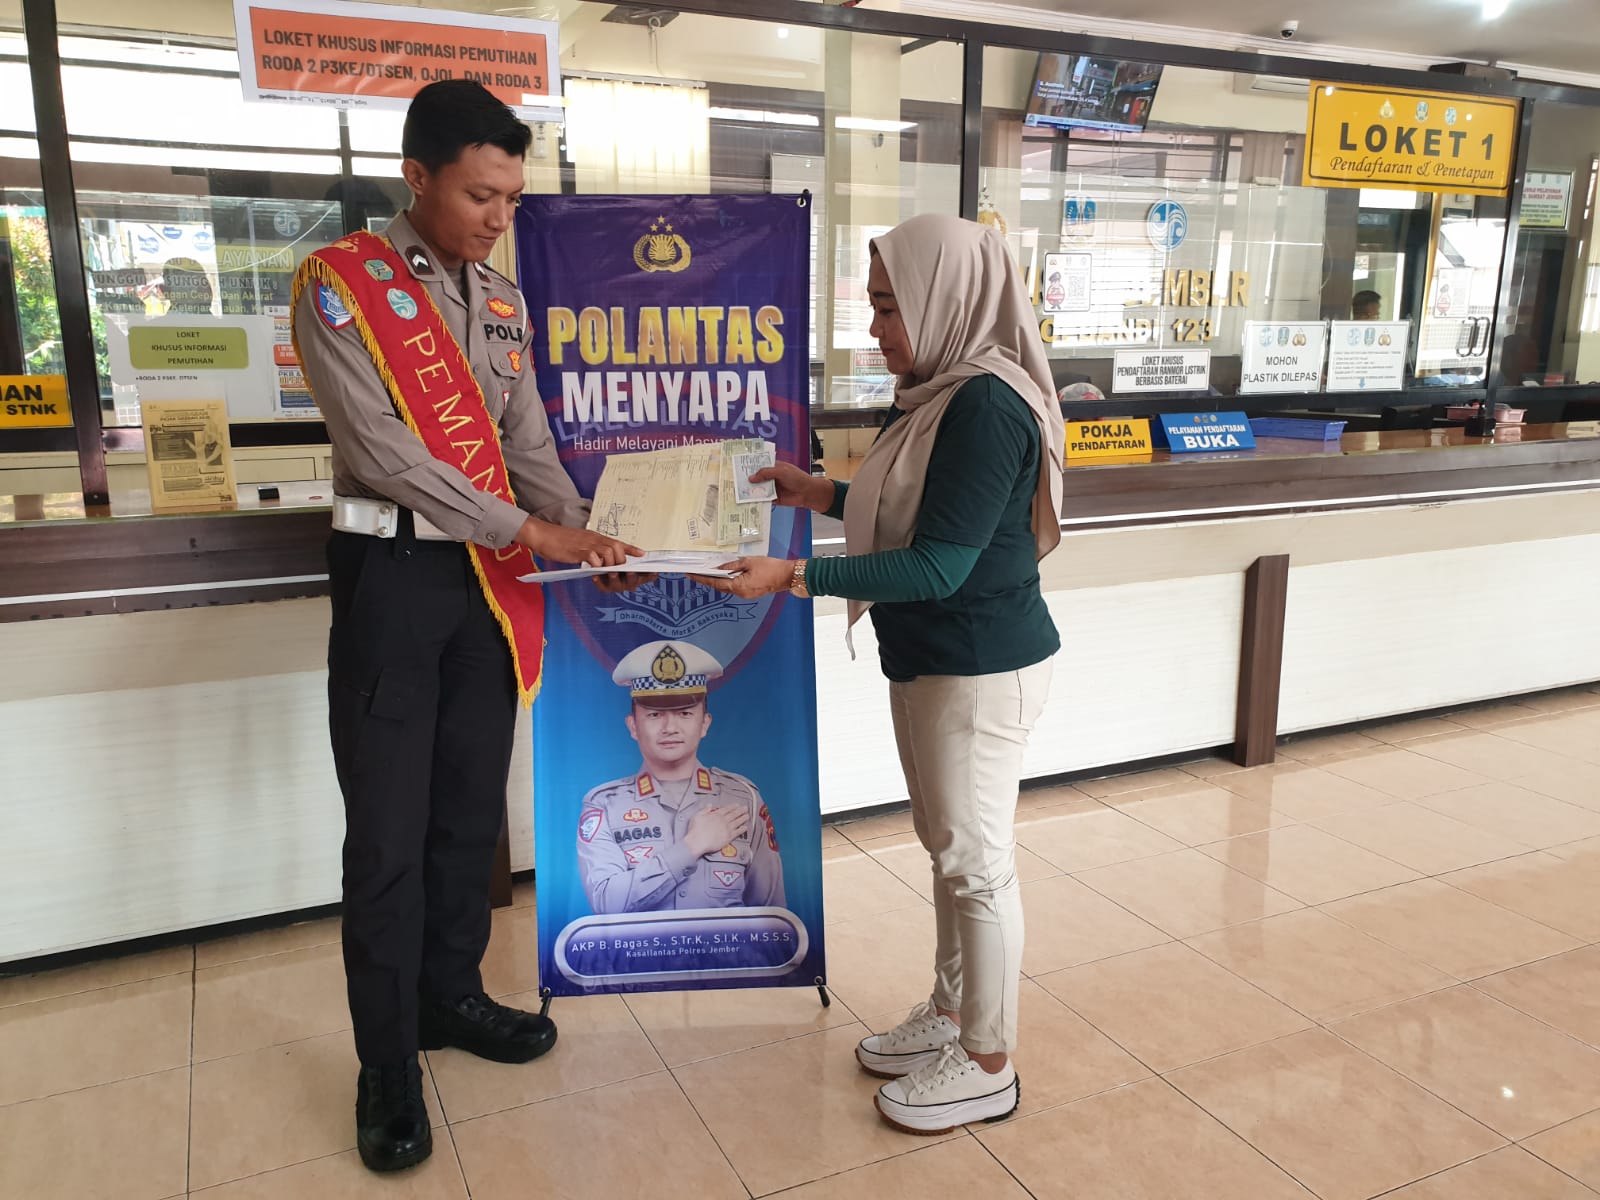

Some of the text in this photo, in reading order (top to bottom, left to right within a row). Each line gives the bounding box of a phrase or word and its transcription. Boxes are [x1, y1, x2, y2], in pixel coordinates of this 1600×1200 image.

[263, 28, 538, 66] LOKET KHUSUS INFORMASI PEMUTIHAN
[261, 54, 304, 74] RODA
[307, 58, 318, 74] 2
[320, 60, 418, 82] P3KE/DTSEN,
[464, 70, 493, 89] DAN
[496, 73, 532, 89] RODA
[534, 76, 542, 90] 3
[1339, 122, 1494, 161] LOKET 1
[1329, 155, 1495, 184] Pendaftaran & Penetapan
[176, 331, 201, 339] LOKET
[547, 305, 785, 365] POLANTAS
[1172, 317, 1214, 343] 123
[151, 344, 227, 352] KHUSUS INFORMASI
[167, 357, 214, 365] PEMUTIHAN
[1141, 355, 1184, 366] LOKET KHUSUS
[1265, 355, 1298, 366] MOHON
[1117, 365, 1206, 376] PENDAFTARAN RANMOR LISTRIK
[1243, 371, 1318, 383] PLASTIK DILEPAS
[1135, 375, 1188, 386] BERBASIS BATERAI
[0, 384, 43, 401] AN
[561, 370, 771, 423] MENYAPA
[6, 404, 57, 416] STNK
[1081, 424, 1133, 438] POKJA
[1168, 424, 1246, 435] PELAYANAN PENDAFTARAN
[574, 435, 610, 451] Hadir
[1071, 439, 1146, 451] PENDAFTARAN
[1183, 434, 1240, 449] BUKA
[613, 826, 663, 844] BAGAS
[571, 941, 595, 953] AKP
[614, 939, 649, 950] Bagas
[708, 945, 740, 954] Jember
